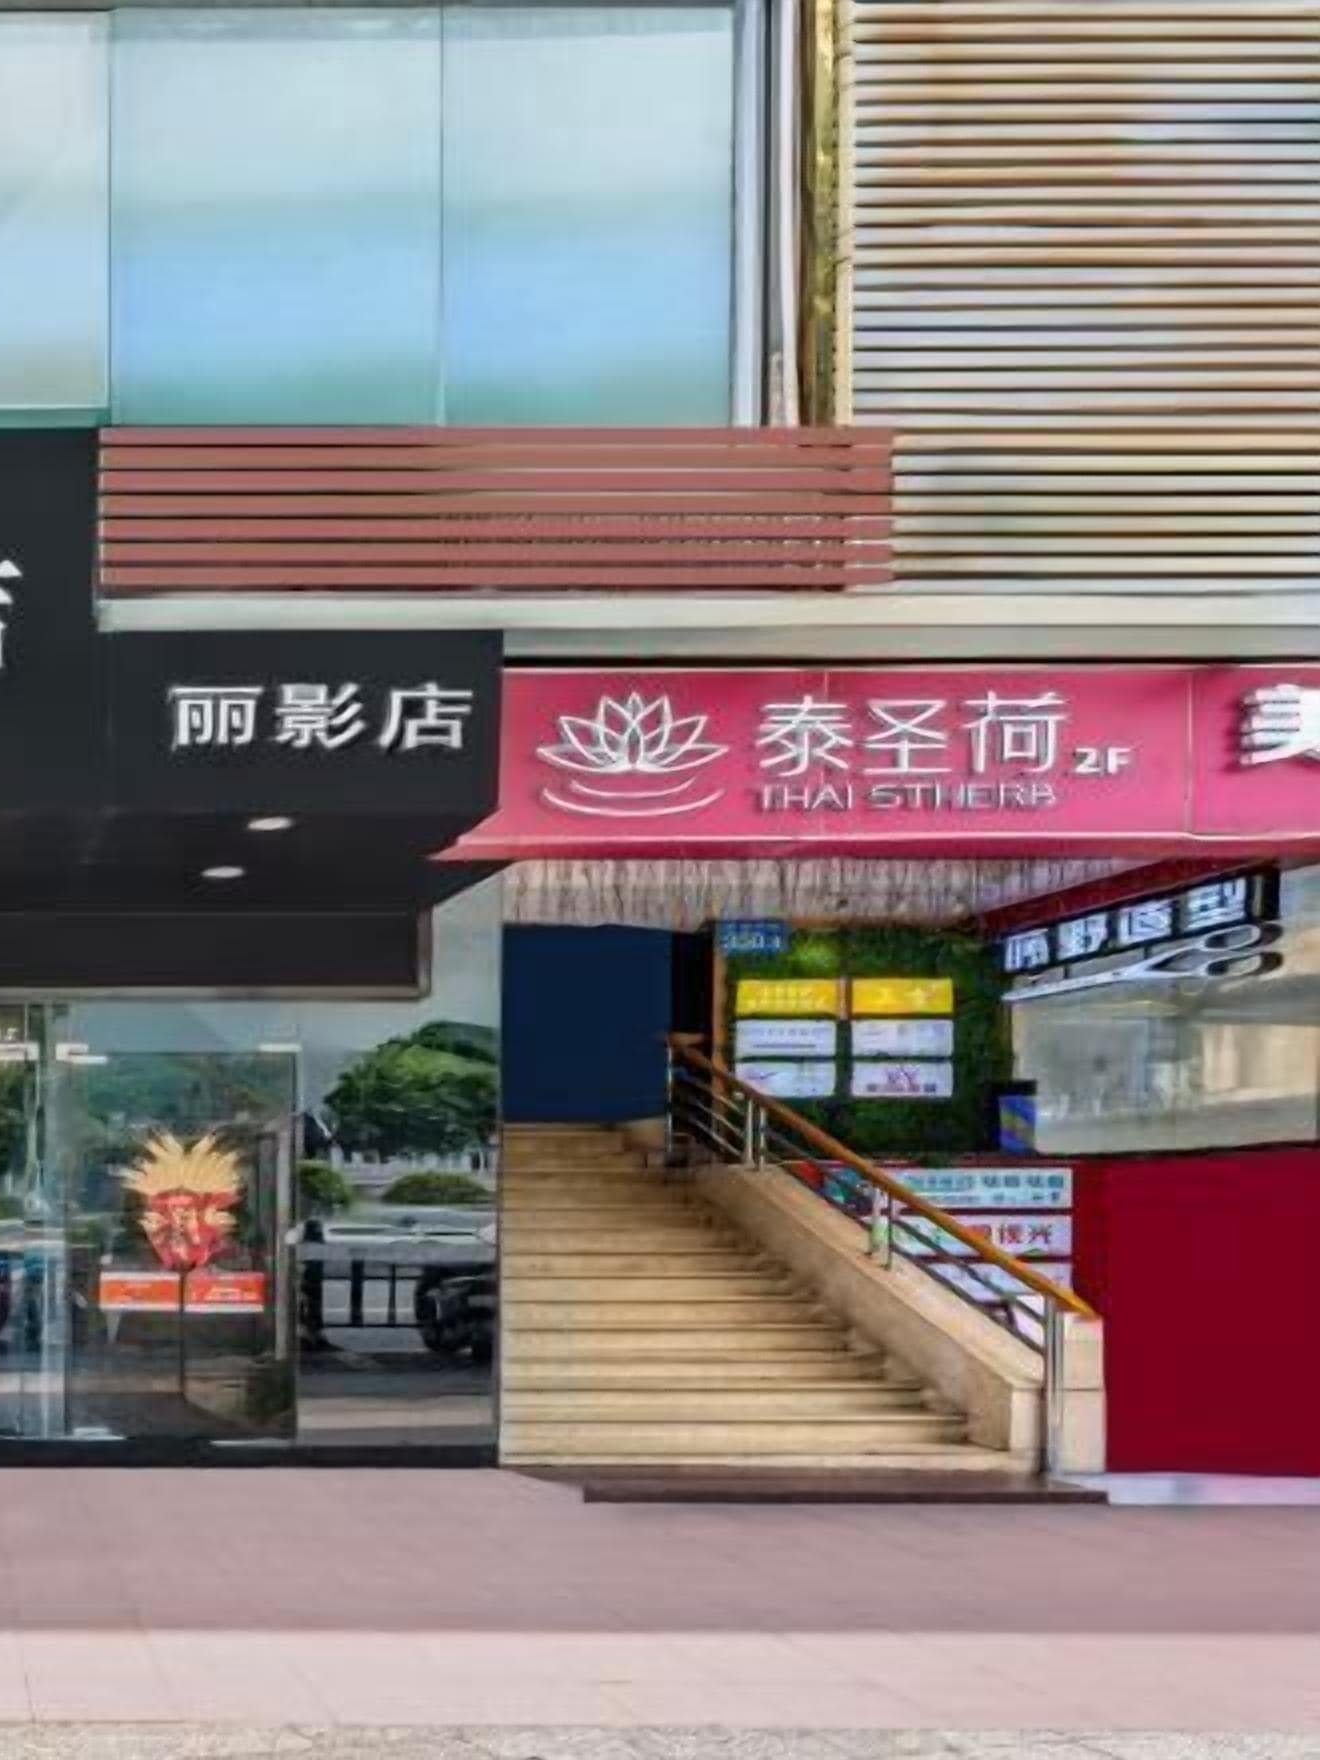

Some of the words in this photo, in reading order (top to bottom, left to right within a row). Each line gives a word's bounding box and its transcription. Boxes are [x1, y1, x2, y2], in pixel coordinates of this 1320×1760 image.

[169, 682, 473, 749] 丽影店
[755, 690, 1068, 777] 泰圣荷
[1073, 745, 1132, 774] 2F
[758, 783, 854, 810] THAI
